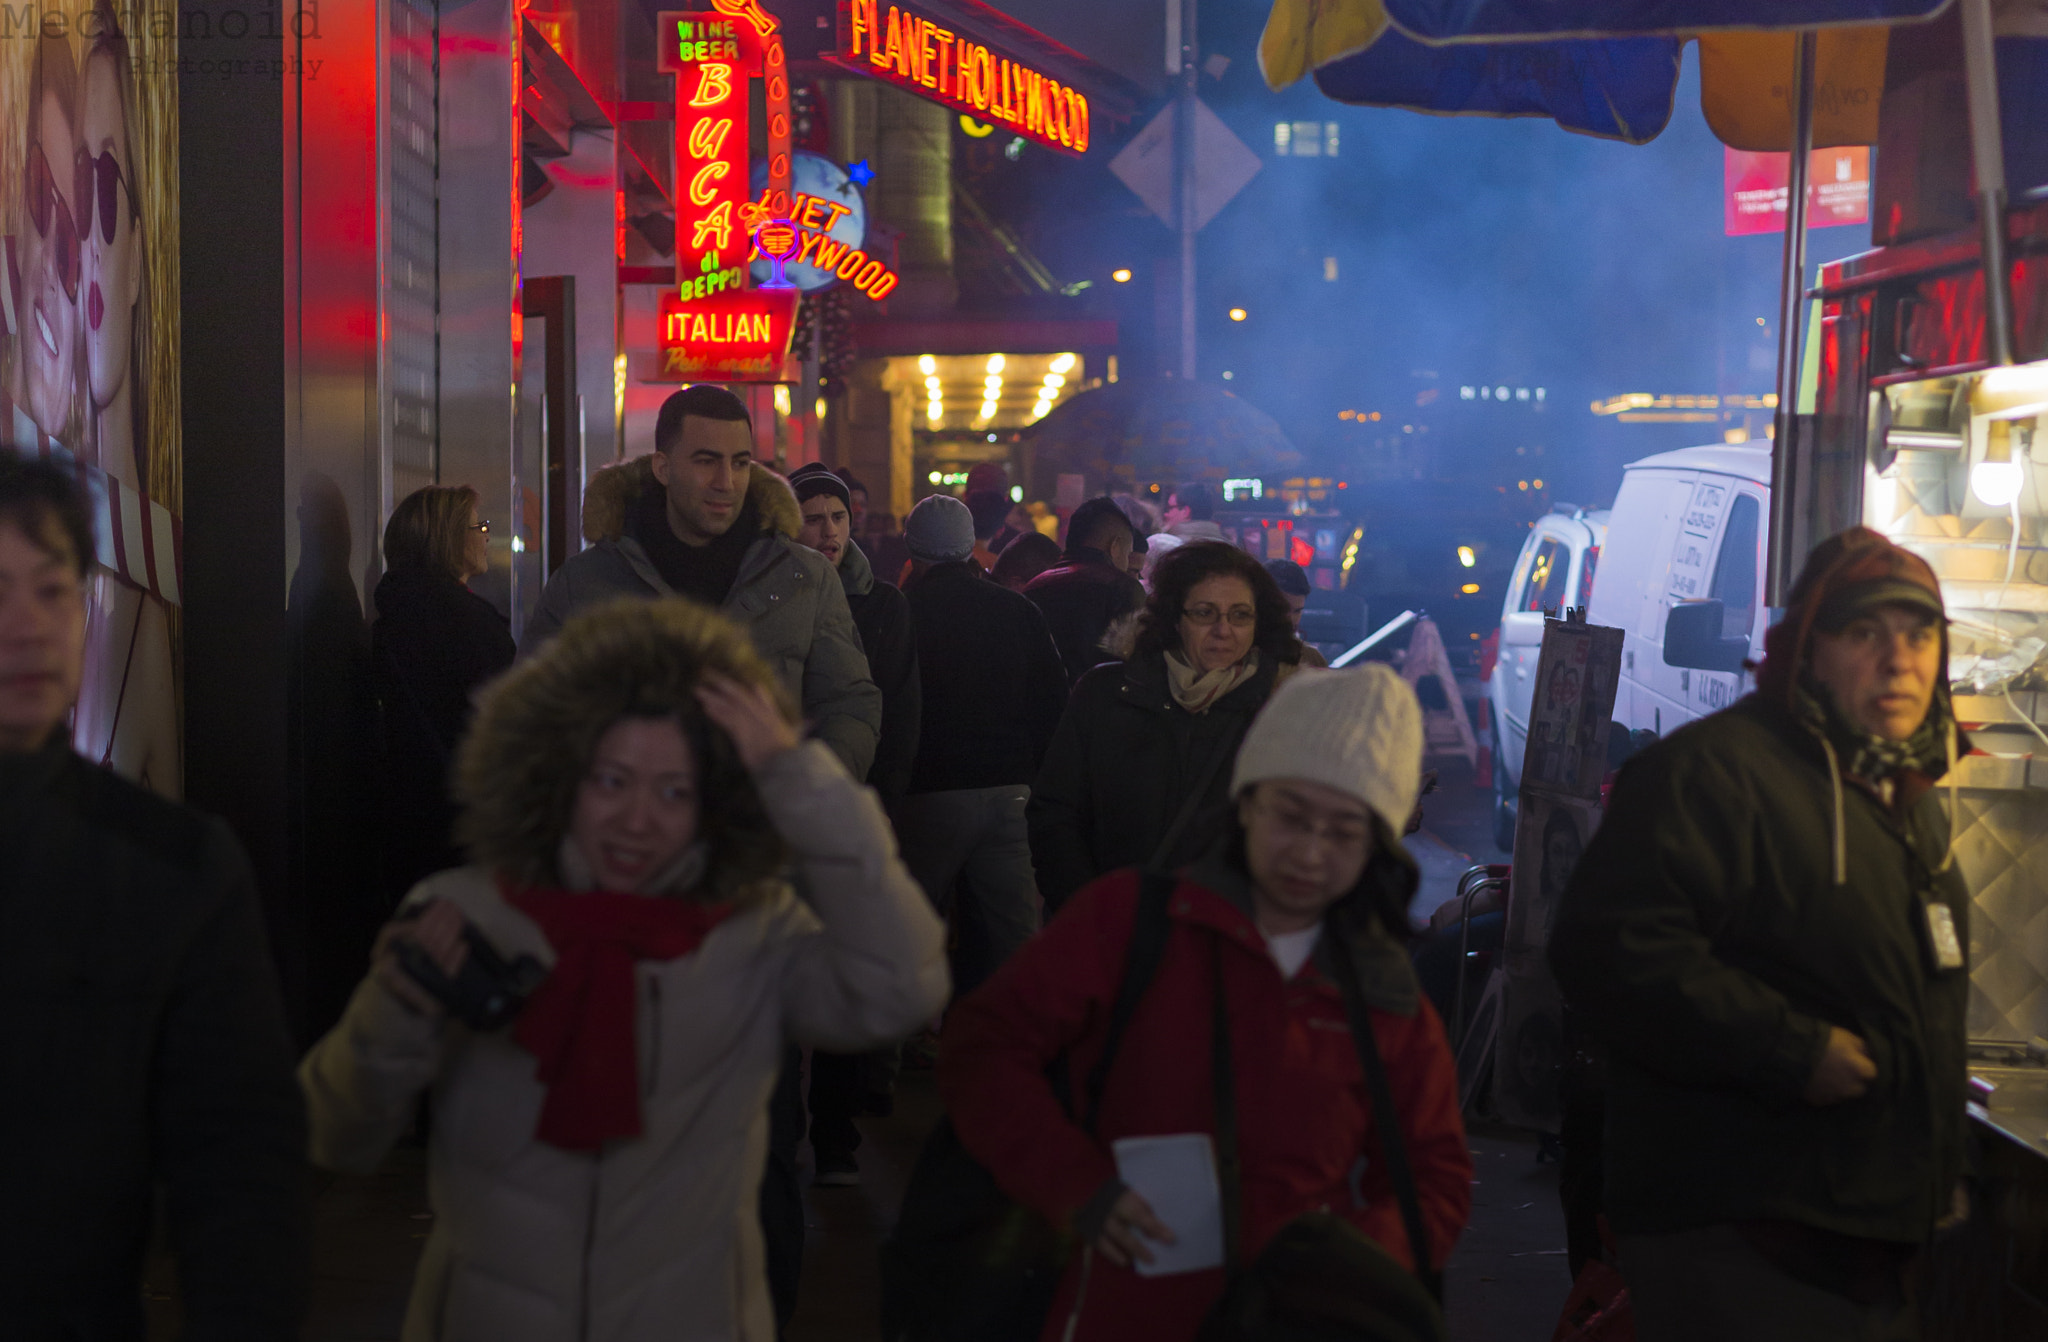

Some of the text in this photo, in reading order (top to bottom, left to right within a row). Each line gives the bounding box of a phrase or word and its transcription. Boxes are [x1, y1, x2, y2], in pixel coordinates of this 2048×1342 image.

[677, 20, 736, 40] WINE
[679, 40, 739, 62] BEER
[851, 0, 1090, 153] PLANET HOLLYWOOD
[688, 62, 734, 251] BUCA
[680, 266, 743, 302] BEPPO
[666, 311, 772, 344] ITALIAN
